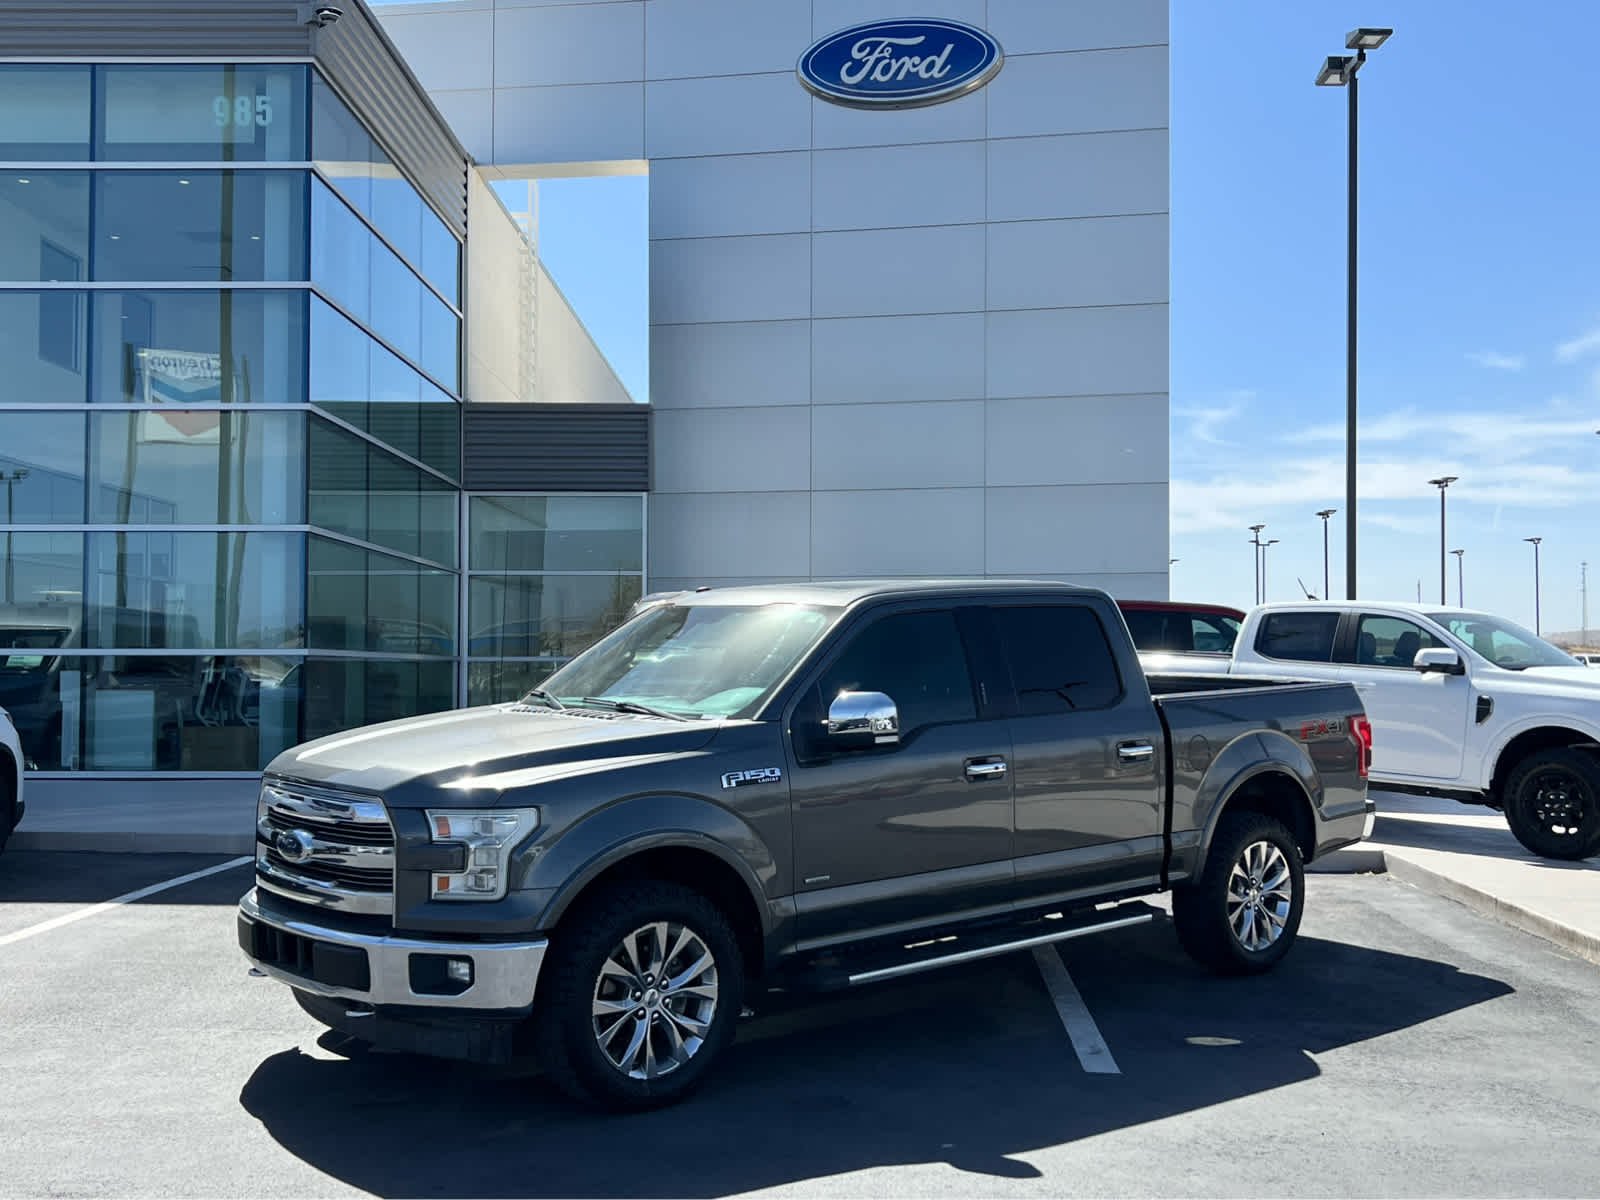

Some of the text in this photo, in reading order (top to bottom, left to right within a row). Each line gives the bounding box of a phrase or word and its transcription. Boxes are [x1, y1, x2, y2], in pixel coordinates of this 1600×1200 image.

[840, 36, 954, 84] Ford
[212, 95, 272, 127] 985
[1299, 720, 1343, 740] FX4
